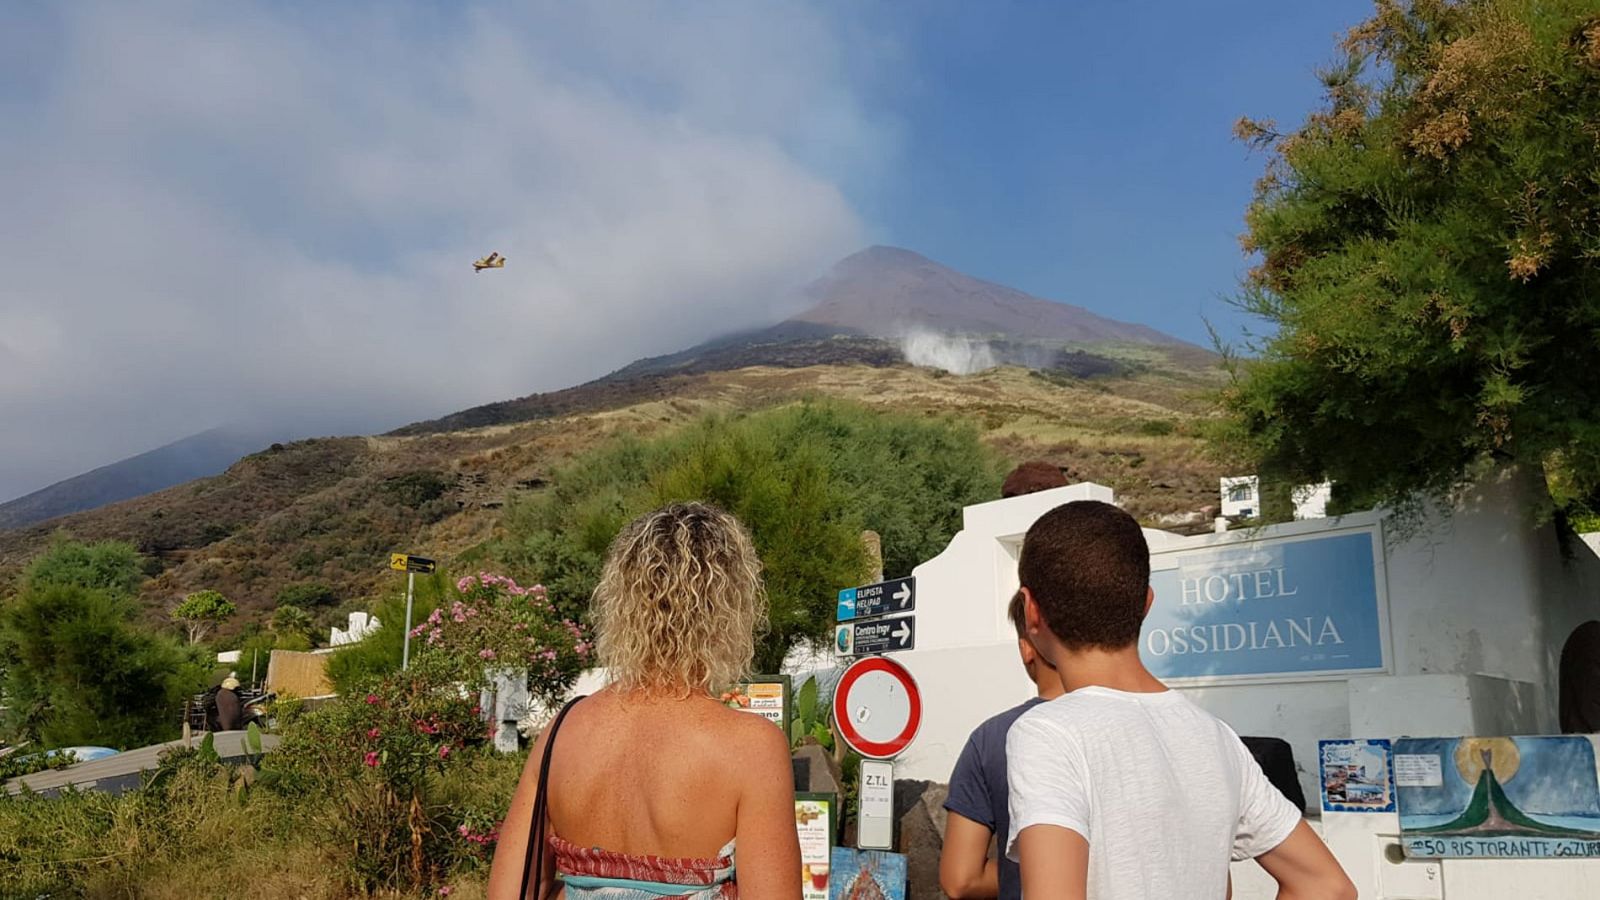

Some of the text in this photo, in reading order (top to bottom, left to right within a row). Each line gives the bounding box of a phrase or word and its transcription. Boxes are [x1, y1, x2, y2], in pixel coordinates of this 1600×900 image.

[857, 586, 883, 599] ELIPISTA
[1180, 567, 1298, 606] HOTEL
[855, 625, 876, 636] Centro
[1147, 615, 1345, 656] OSSIDIANA
